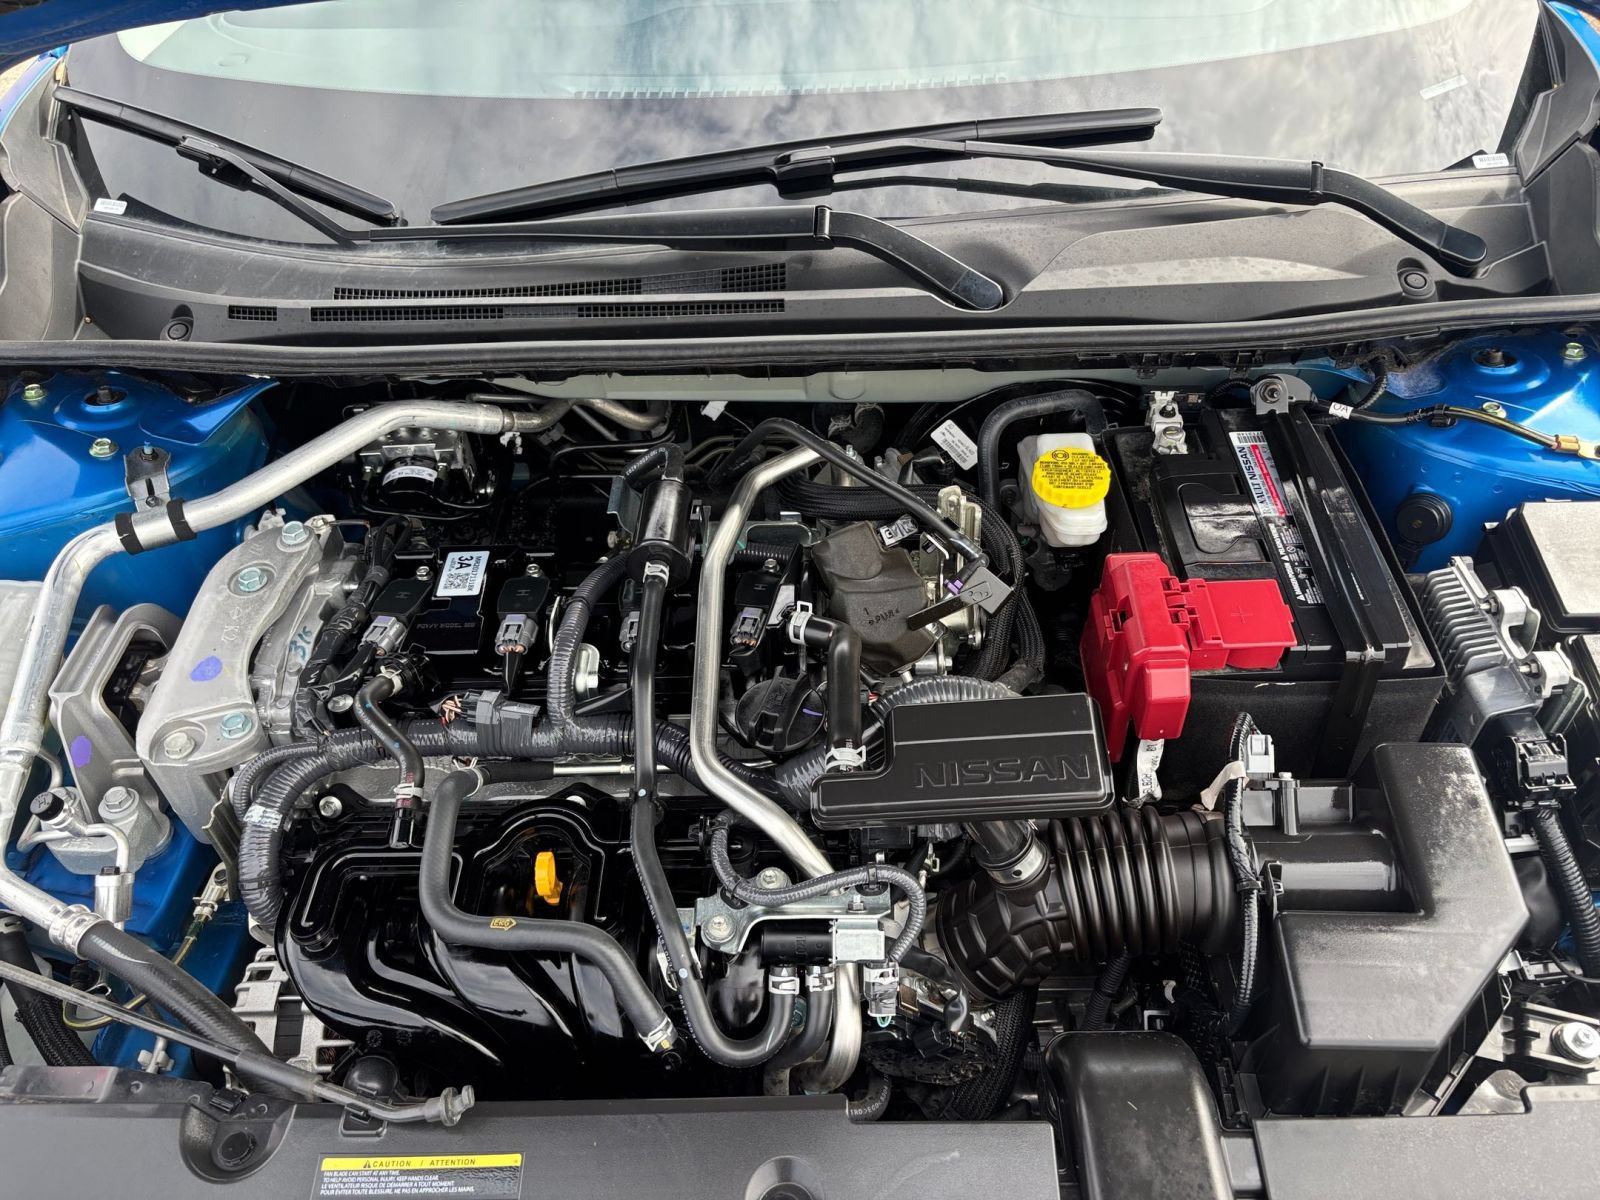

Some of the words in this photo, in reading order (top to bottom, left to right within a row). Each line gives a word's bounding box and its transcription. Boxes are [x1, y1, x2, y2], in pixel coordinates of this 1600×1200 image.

[1236, 446, 1257, 480] NISSAN
[455, 556, 474, 570] 3A
[914, 754, 1091, 788] NISSAN
[372, 1160, 412, 1168] CAUTION
[429, 1158, 476, 1166] ATTENTION
